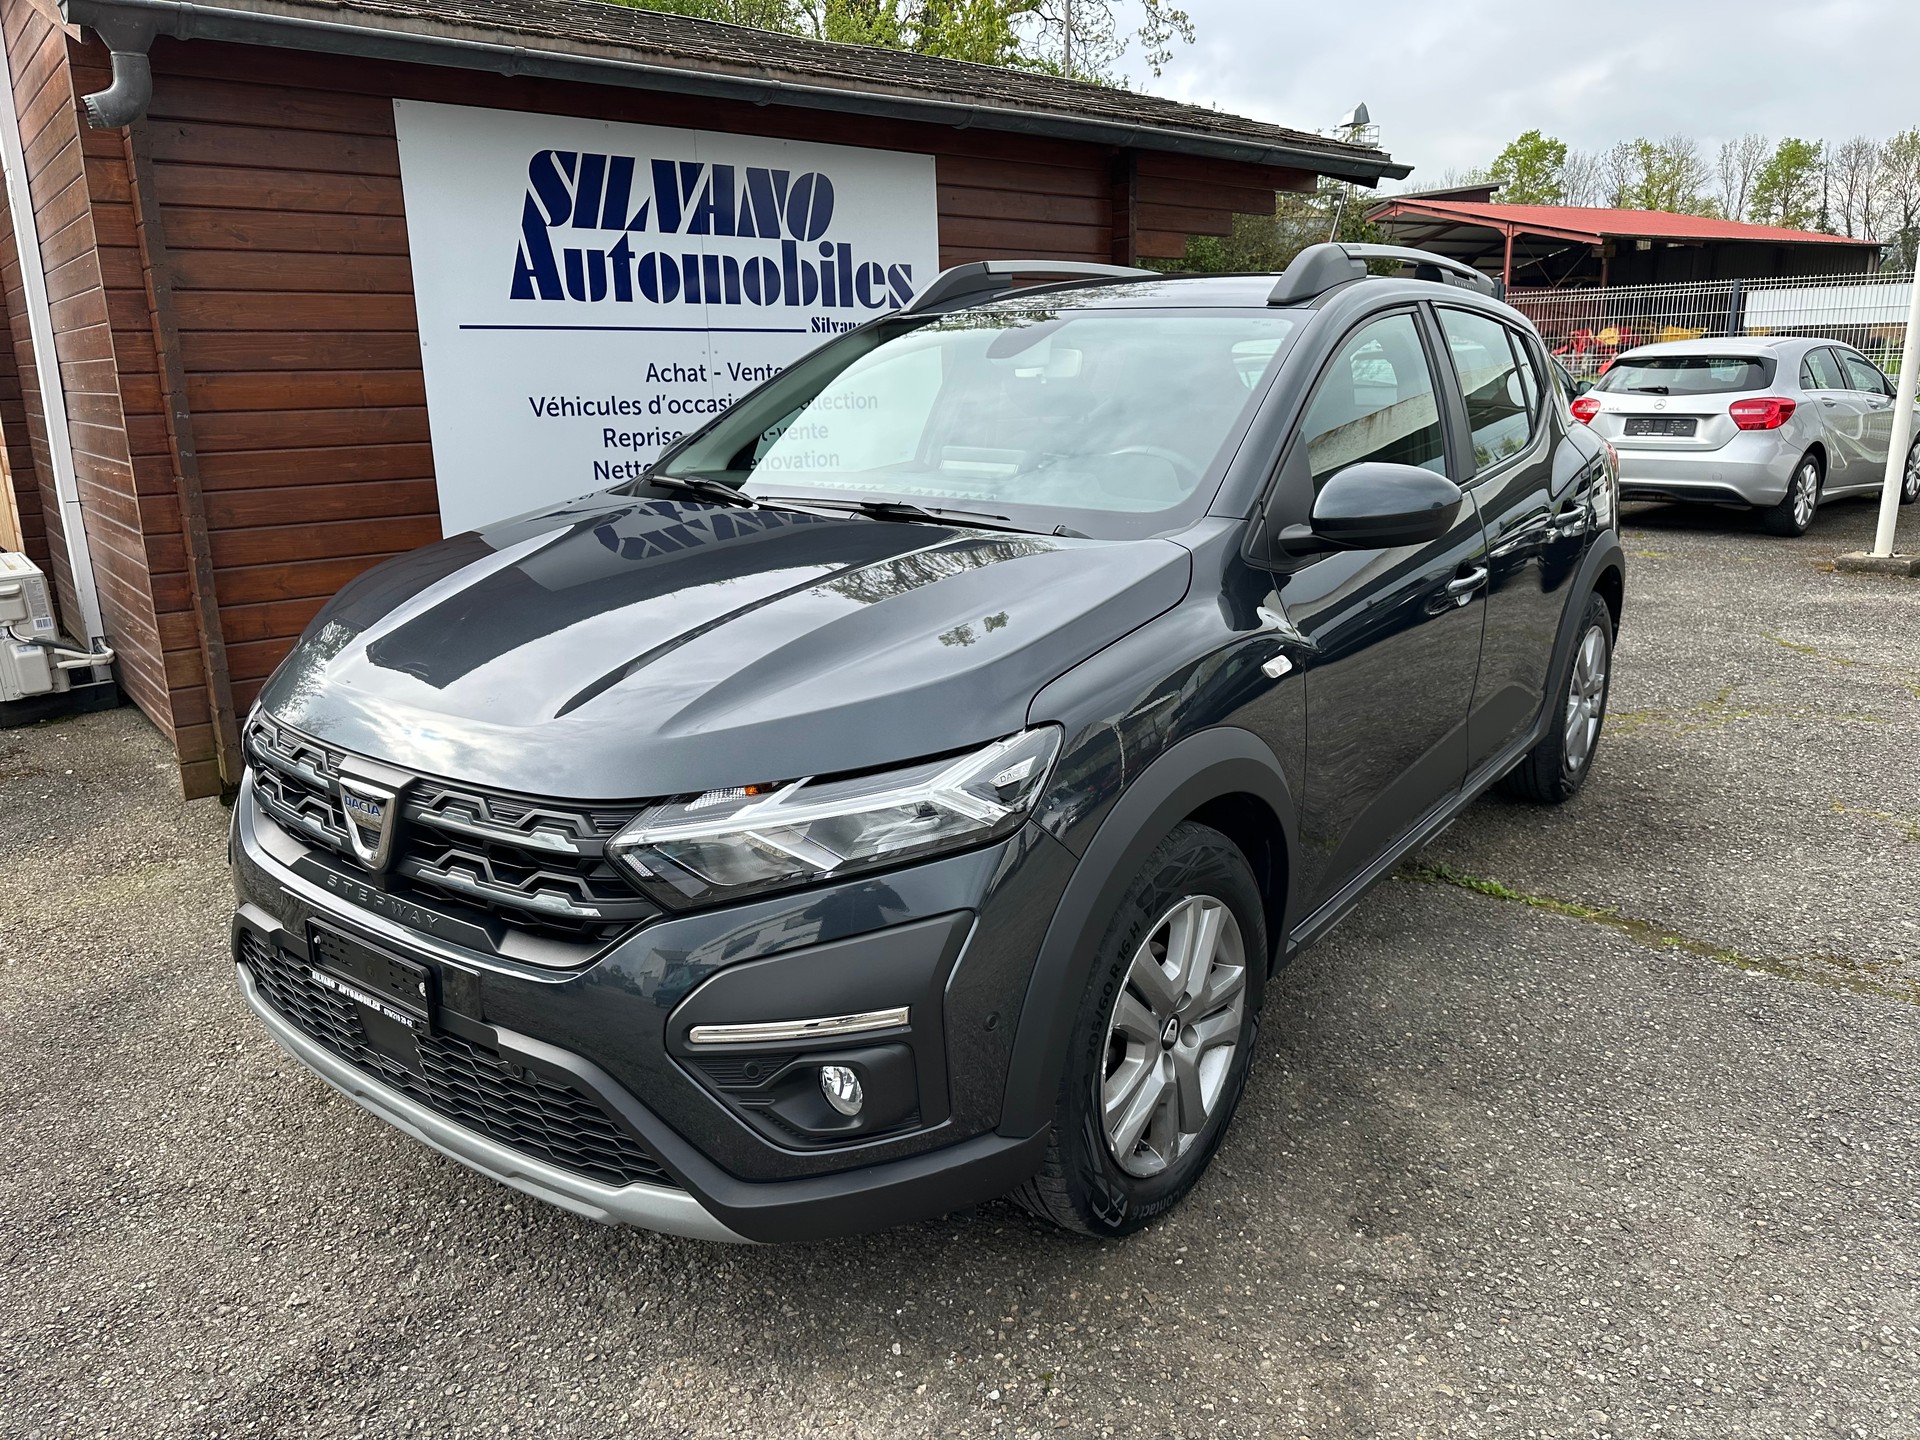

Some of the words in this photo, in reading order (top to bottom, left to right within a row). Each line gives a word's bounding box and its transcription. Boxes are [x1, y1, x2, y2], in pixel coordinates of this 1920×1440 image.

[528, 149, 835, 242] SILVANO
[510, 188, 916, 310] Automobiles
[811, 317, 863, 333] Silvan
[646, 363, 707, 382] Achat
[528, 394, 642, 417] Véhicules
[648, 393, 741, 414] d'occasi
[999, 765, 1029, 783] DAA
[344, 794, 381, 816] DACIA
[326, 874, 439, 929] STEPWAY
[1086, 982, 1114, 1061] 205/60
[1129, 920, 1142, 940] H
